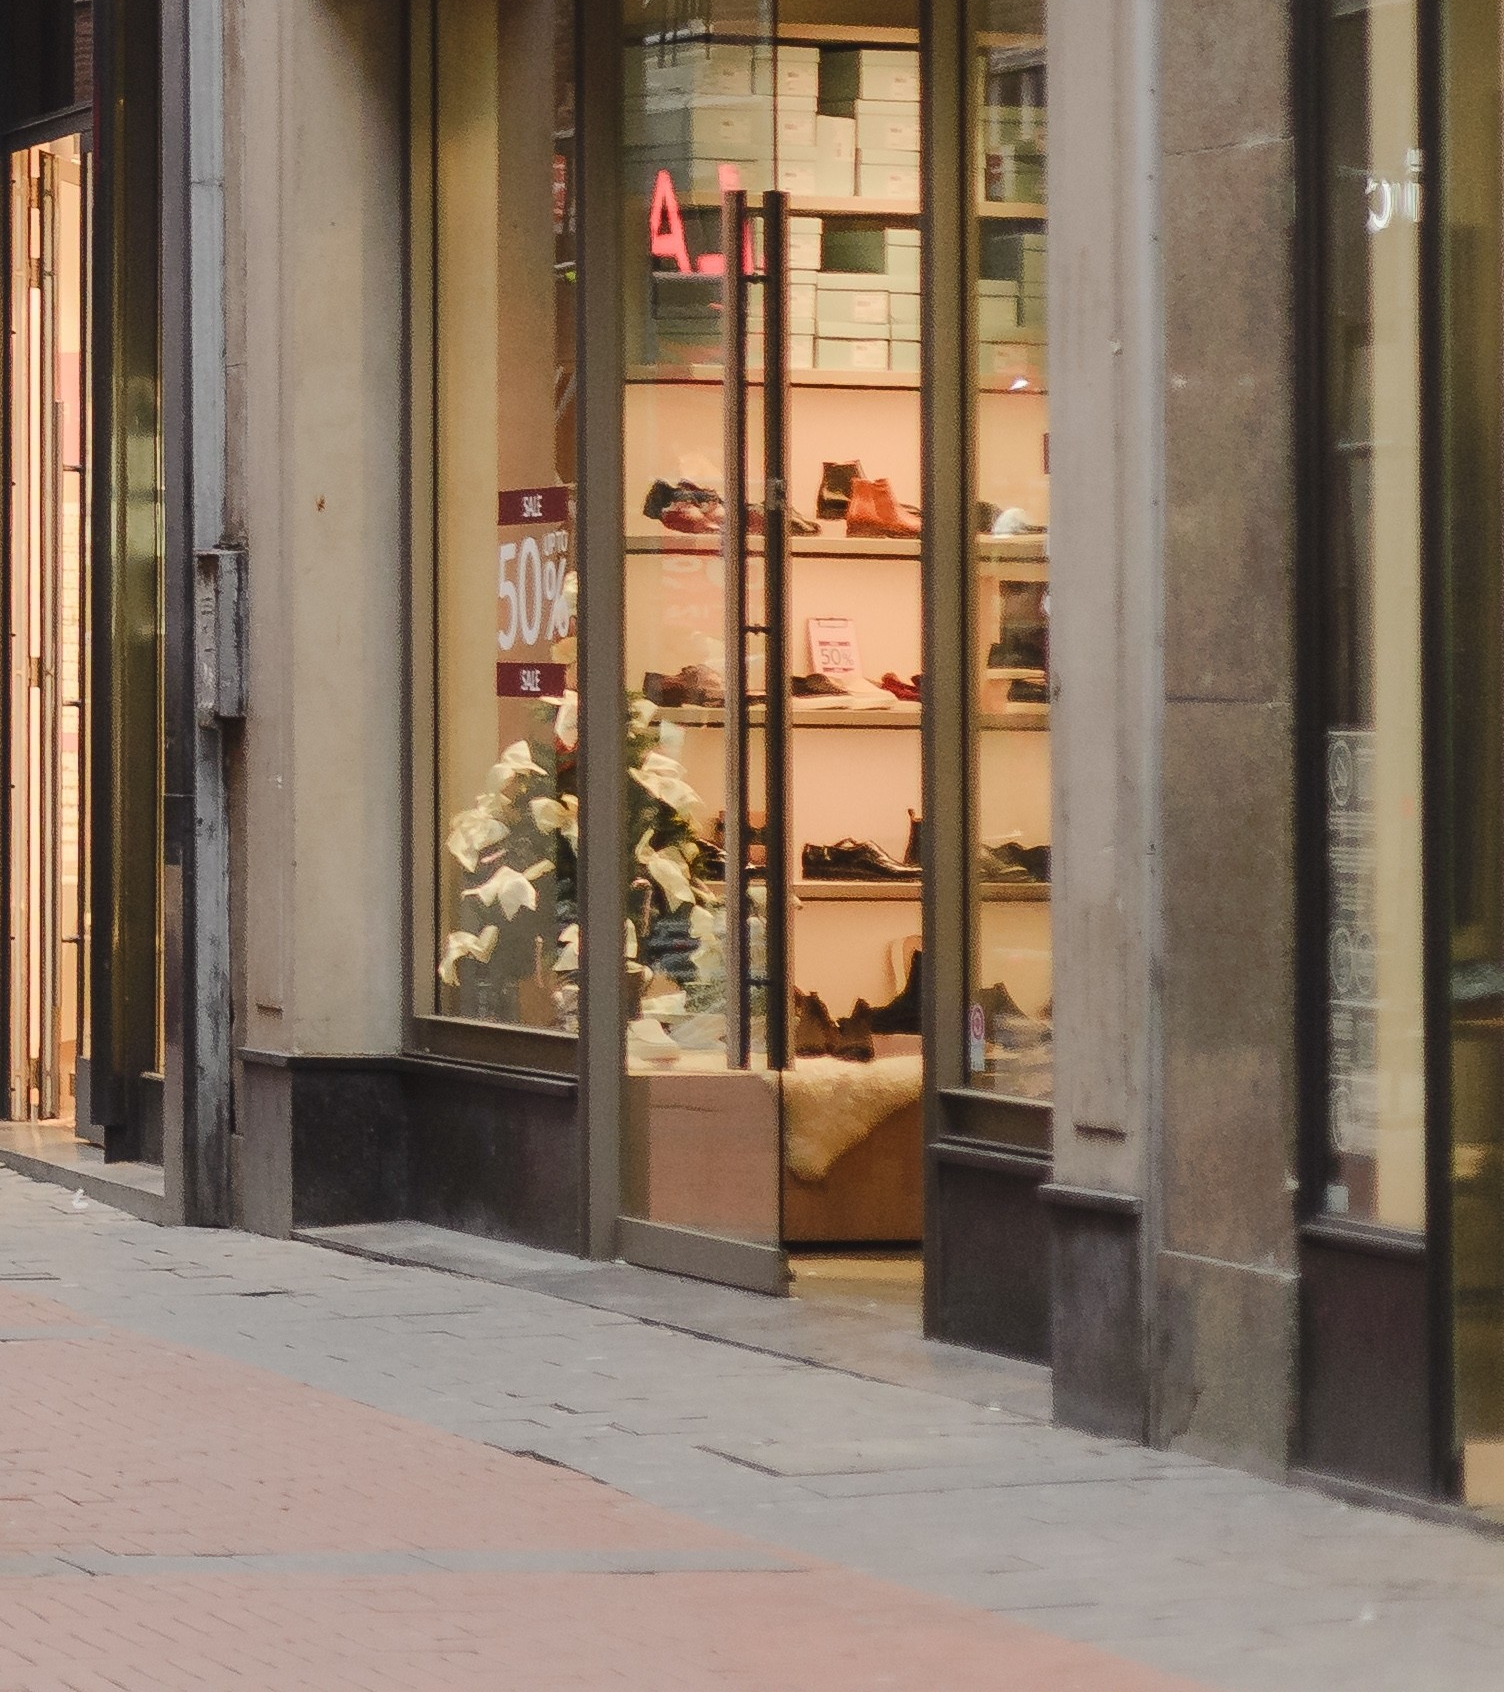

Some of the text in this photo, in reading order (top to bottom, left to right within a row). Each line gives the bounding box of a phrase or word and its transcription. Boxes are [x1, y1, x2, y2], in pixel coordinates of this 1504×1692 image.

[522, 494, 543, 518] SALE
[498, 536, 569, 651] 50%
[521, 668, 541, 692] SALE
